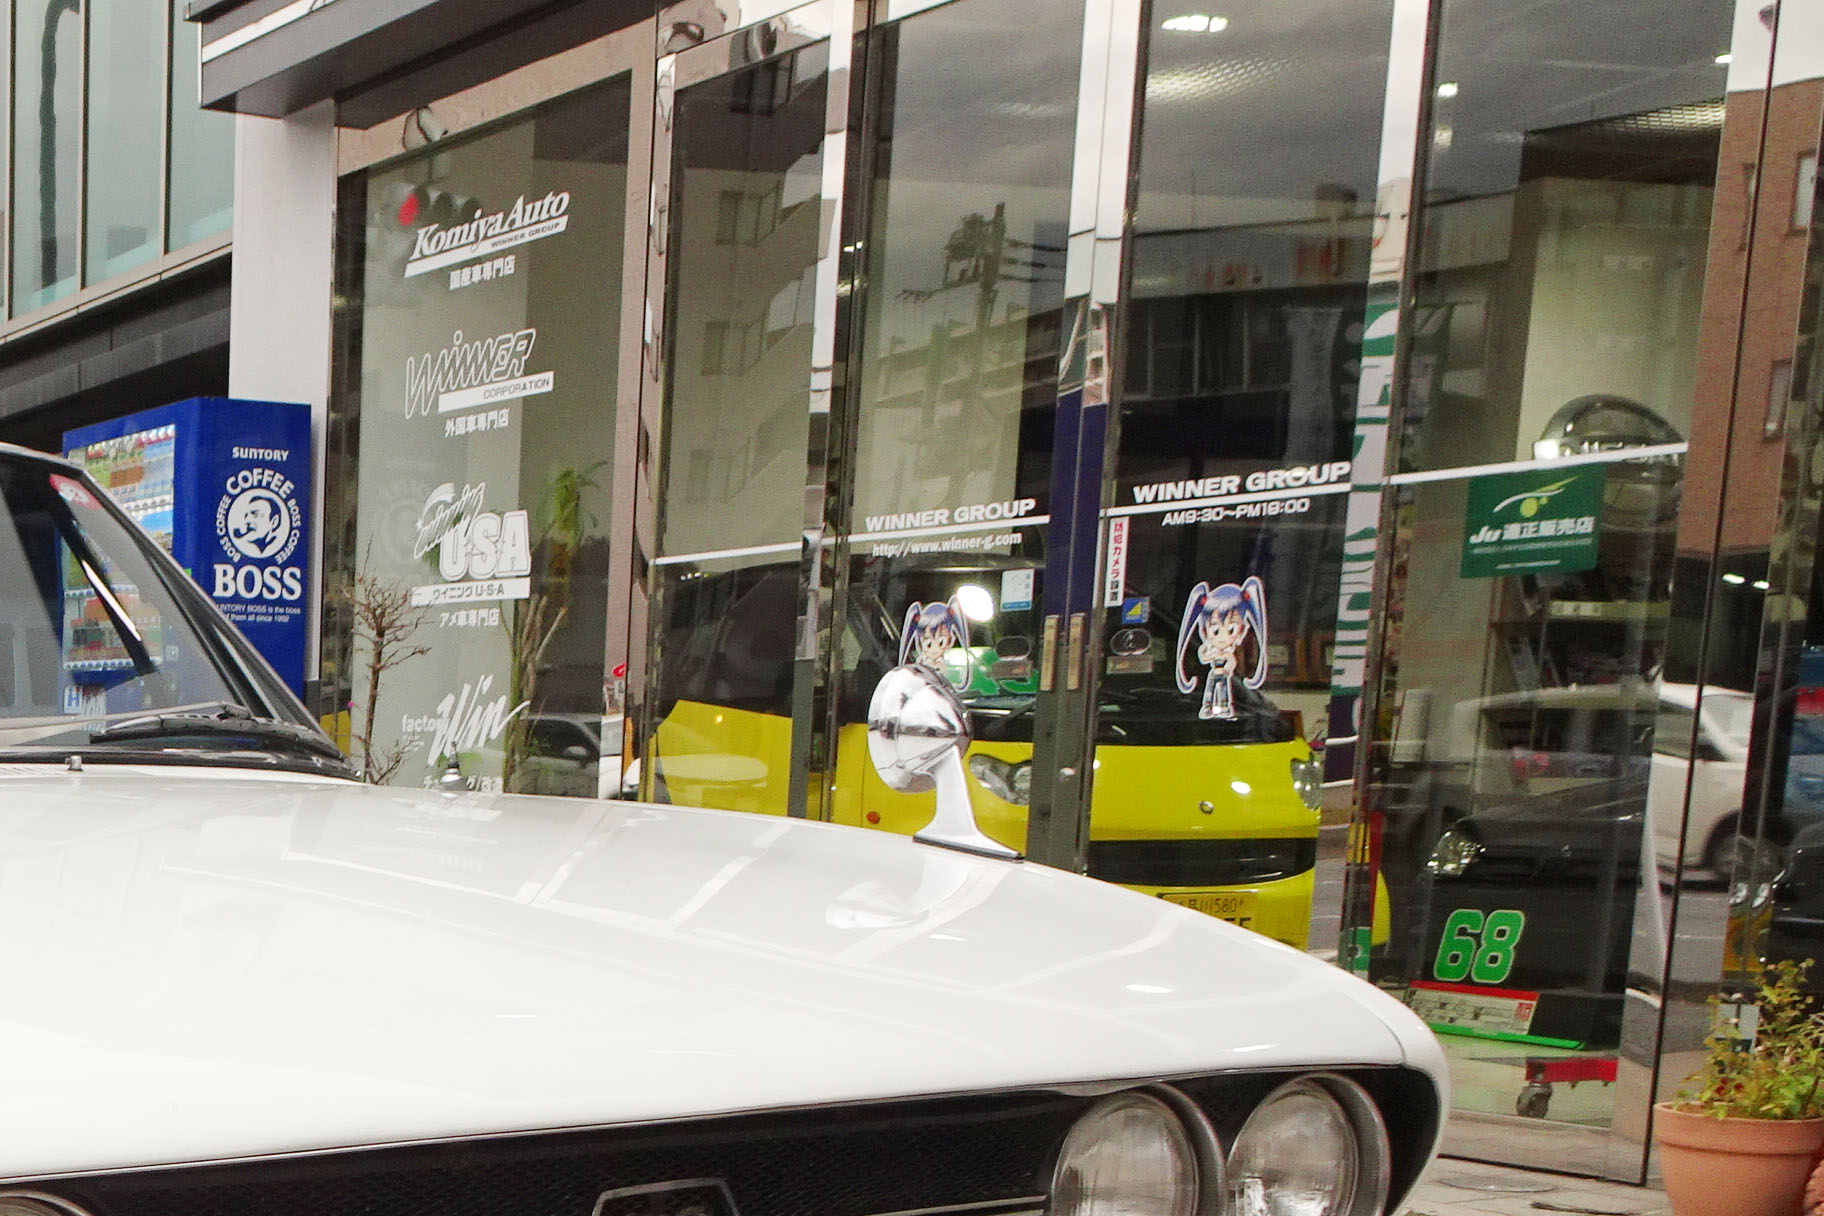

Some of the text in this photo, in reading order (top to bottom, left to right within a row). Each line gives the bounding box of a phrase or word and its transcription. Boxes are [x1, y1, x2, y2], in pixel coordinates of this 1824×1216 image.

[483, 376, 551, 401] CORPORATION
[232, 446, 289, 461] SUNTORY
[226, 468, 295, 499] COFFEE
[1133, 461, 1353, 504] WINNER GROUP
[215, 494, 242, 563] BOSS COFFEE
[274, 498, 302, 565] BOSS COFFEE
[865, 498, 1037, 532] WINNER GROUP
[439, 509, 532, 582] USA
[872, 532, 1023, 558] http://www.winner-g.com
[212, 563, 302, 601] BOSS
[1433, 908, 1525, 984] 68
